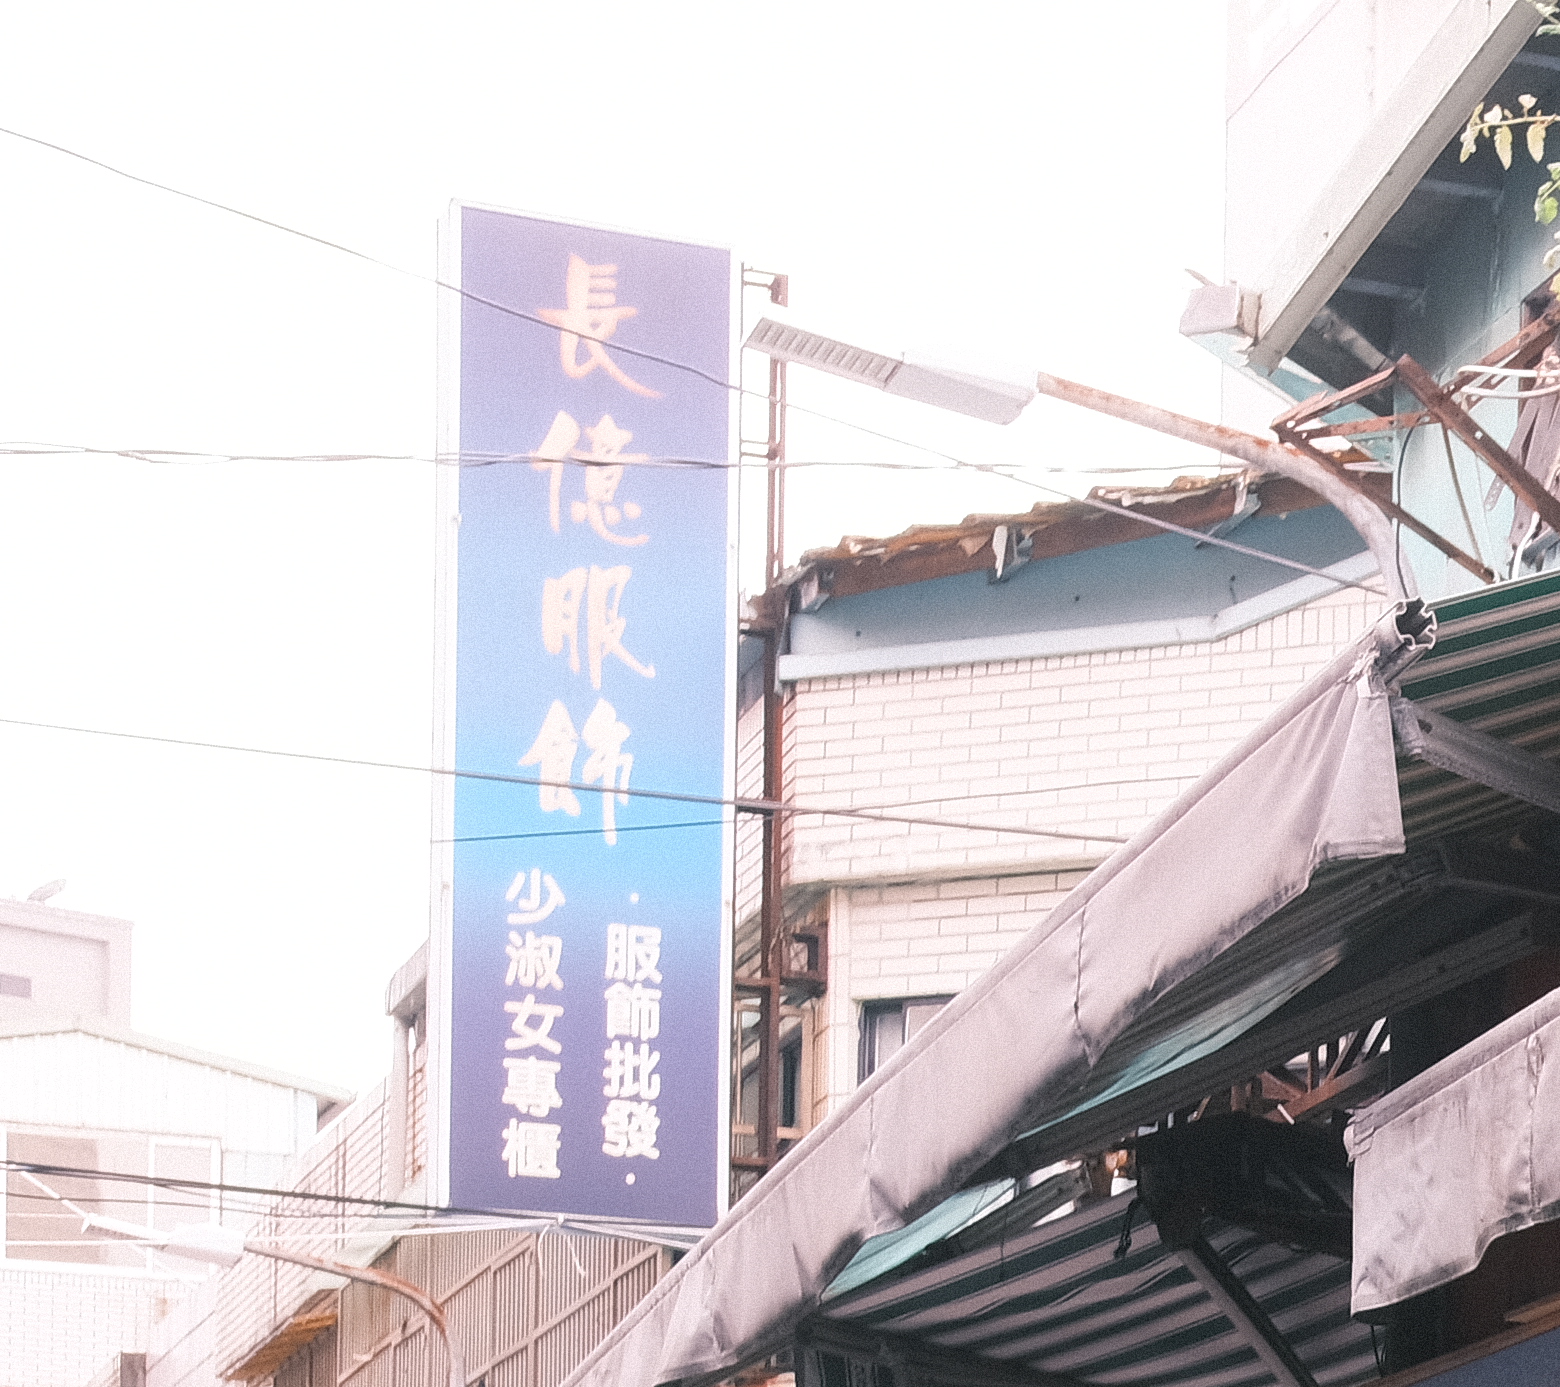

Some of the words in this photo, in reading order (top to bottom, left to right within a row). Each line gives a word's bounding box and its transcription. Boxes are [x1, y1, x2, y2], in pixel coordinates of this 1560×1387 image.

[503, 868, 565, 1178] 少淑女專櫃
